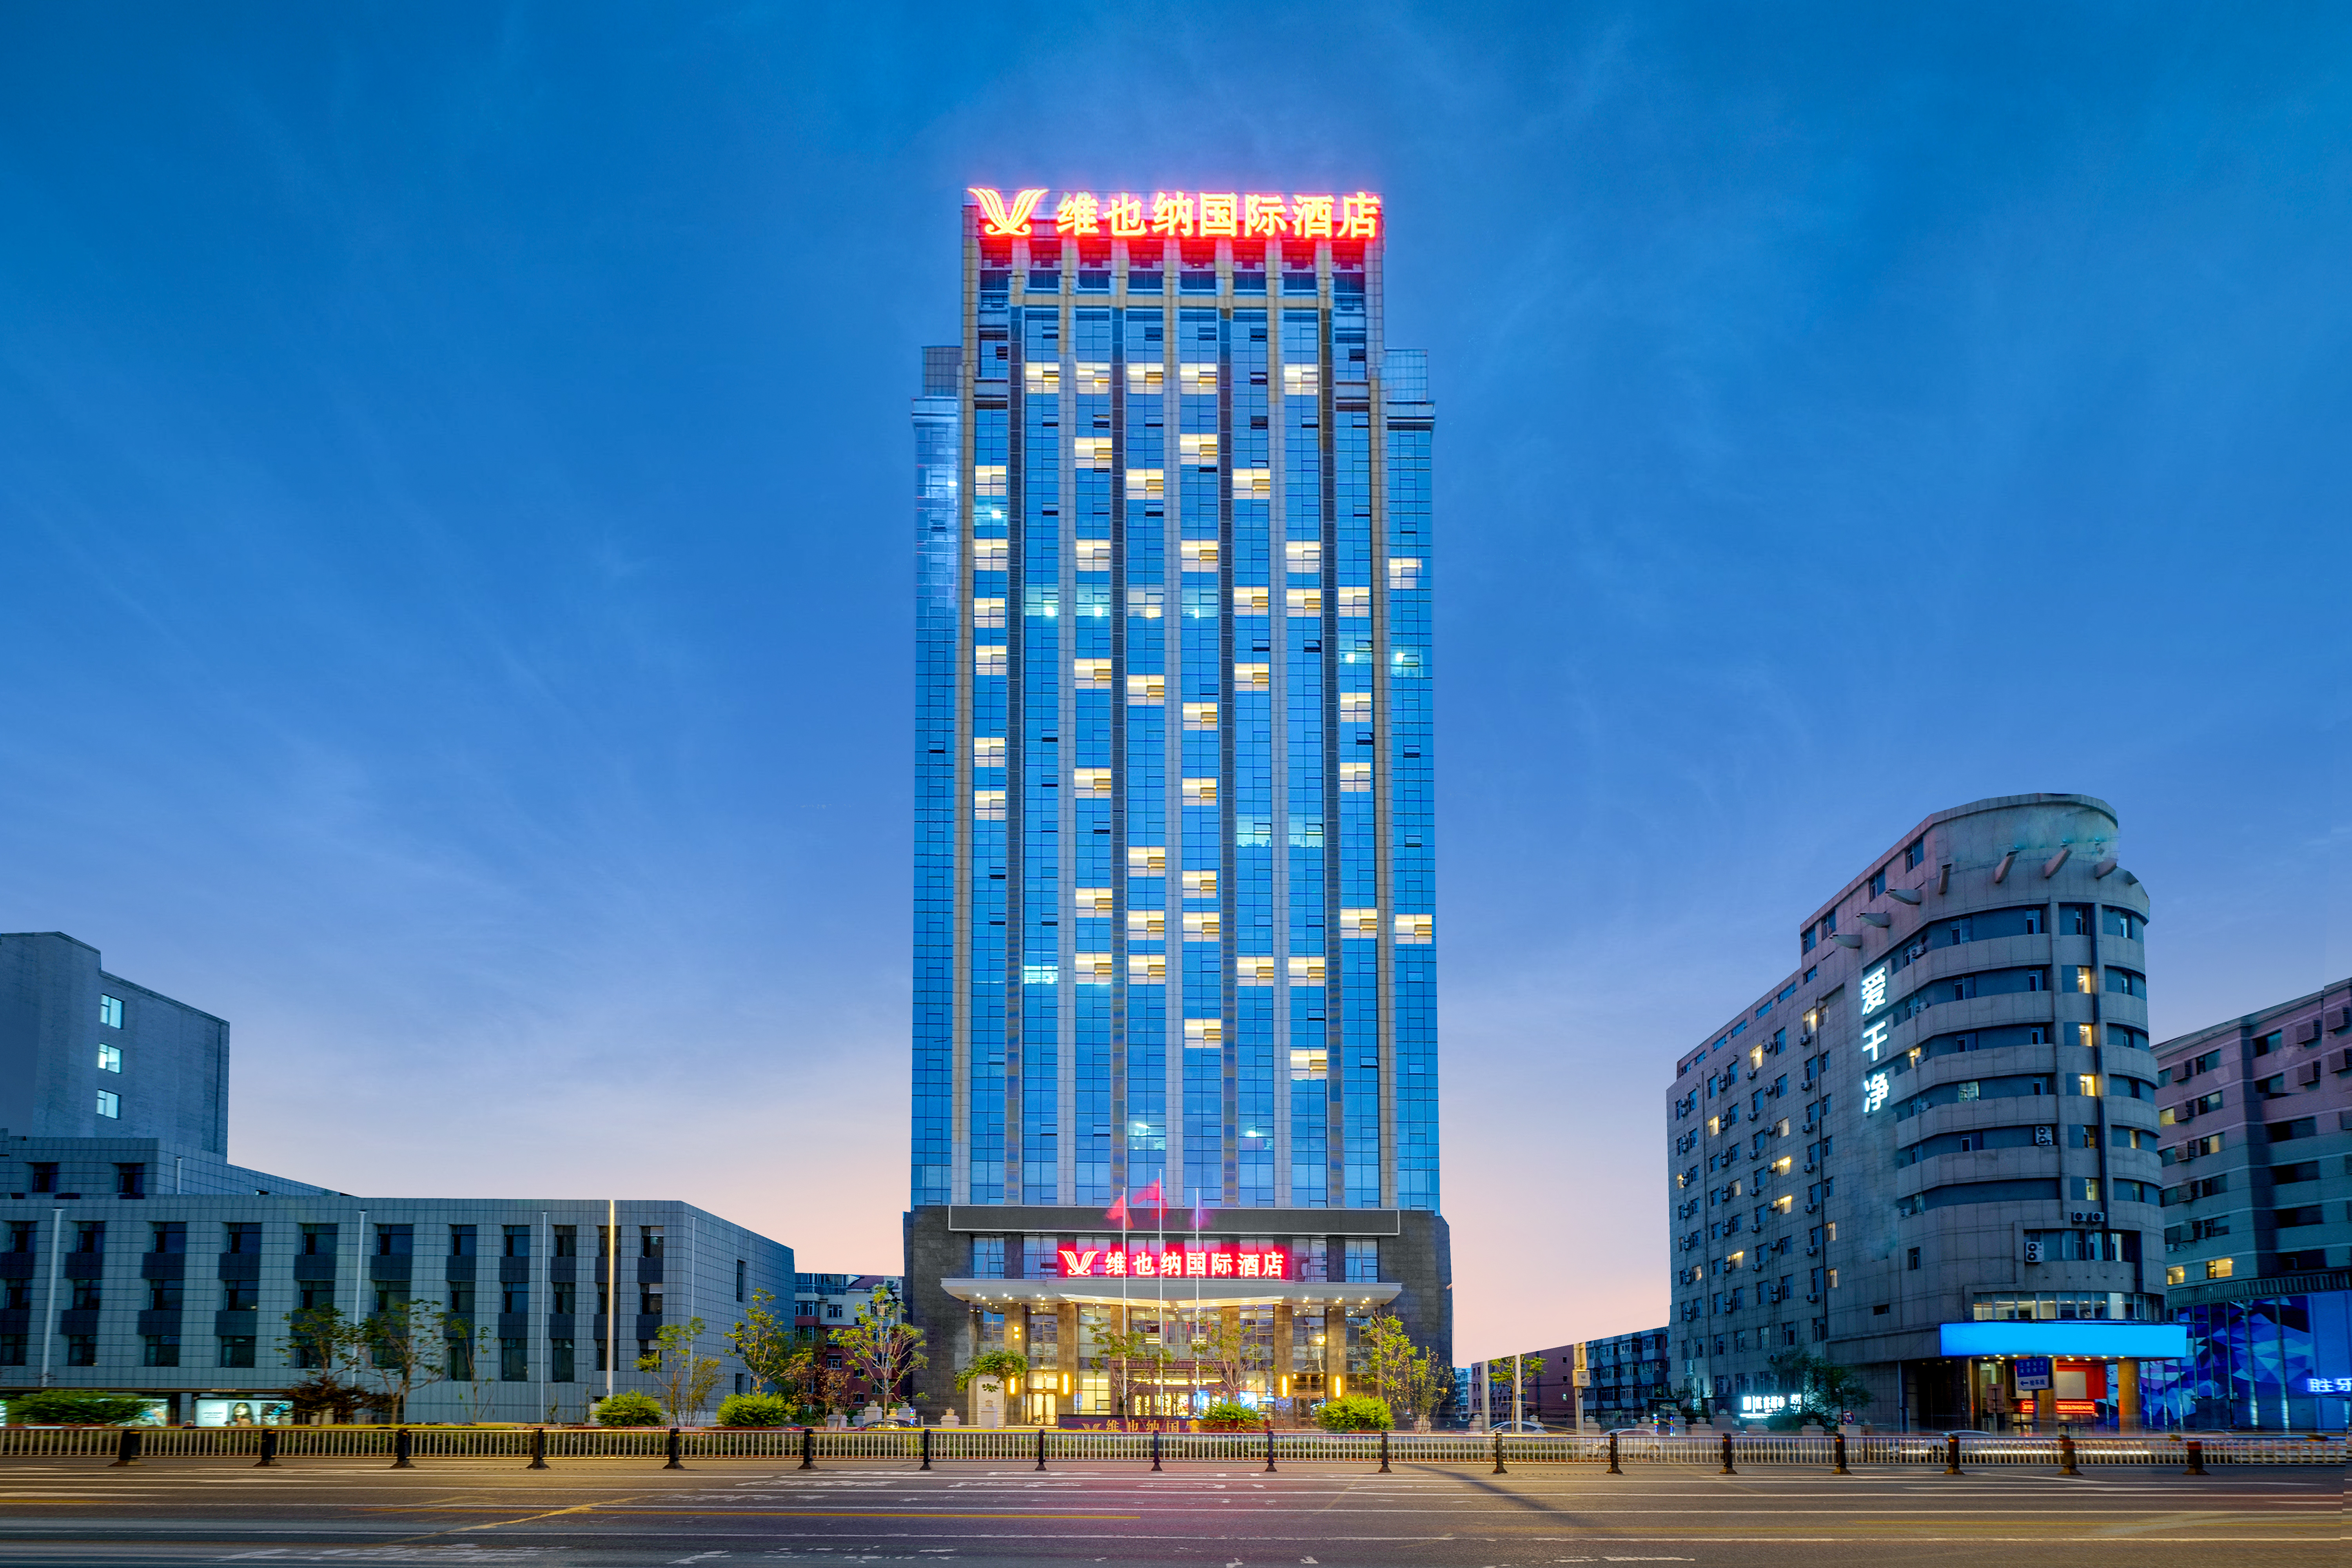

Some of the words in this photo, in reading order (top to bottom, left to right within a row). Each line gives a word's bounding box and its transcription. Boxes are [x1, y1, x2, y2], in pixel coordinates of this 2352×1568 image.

[1056, 191, 1381, 238] 维也纳国际酒店
[1862, 967, 1889, 1113] 爱干净
[1105, 1251, 1285, 1277] 维也纳国际酒店
